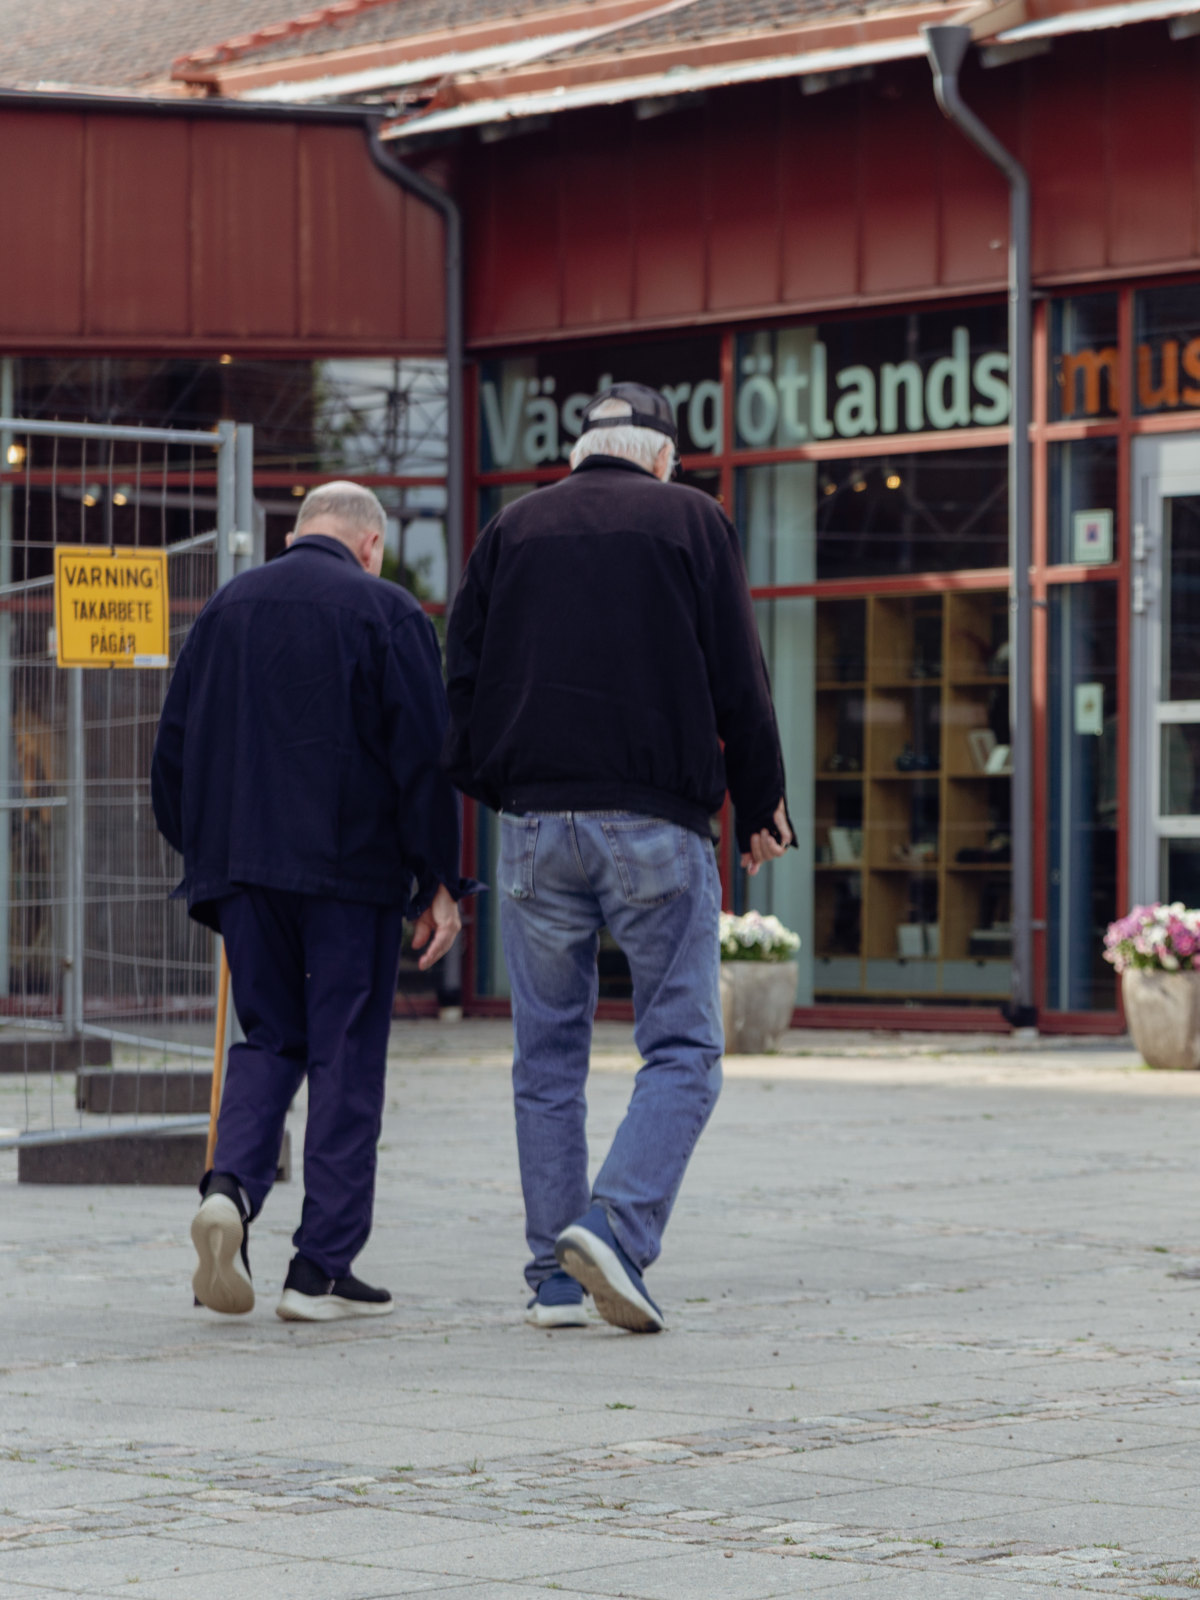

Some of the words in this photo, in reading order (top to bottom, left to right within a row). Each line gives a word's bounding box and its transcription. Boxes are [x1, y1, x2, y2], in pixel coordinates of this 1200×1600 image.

[480, 325, 1013, 466] Väsrgötlands
[64, 565, 160, 589] VARNING!
[72, 600, 153, 623] TAKARBETE
[90, 626, 136, 654] PÅGÅR
